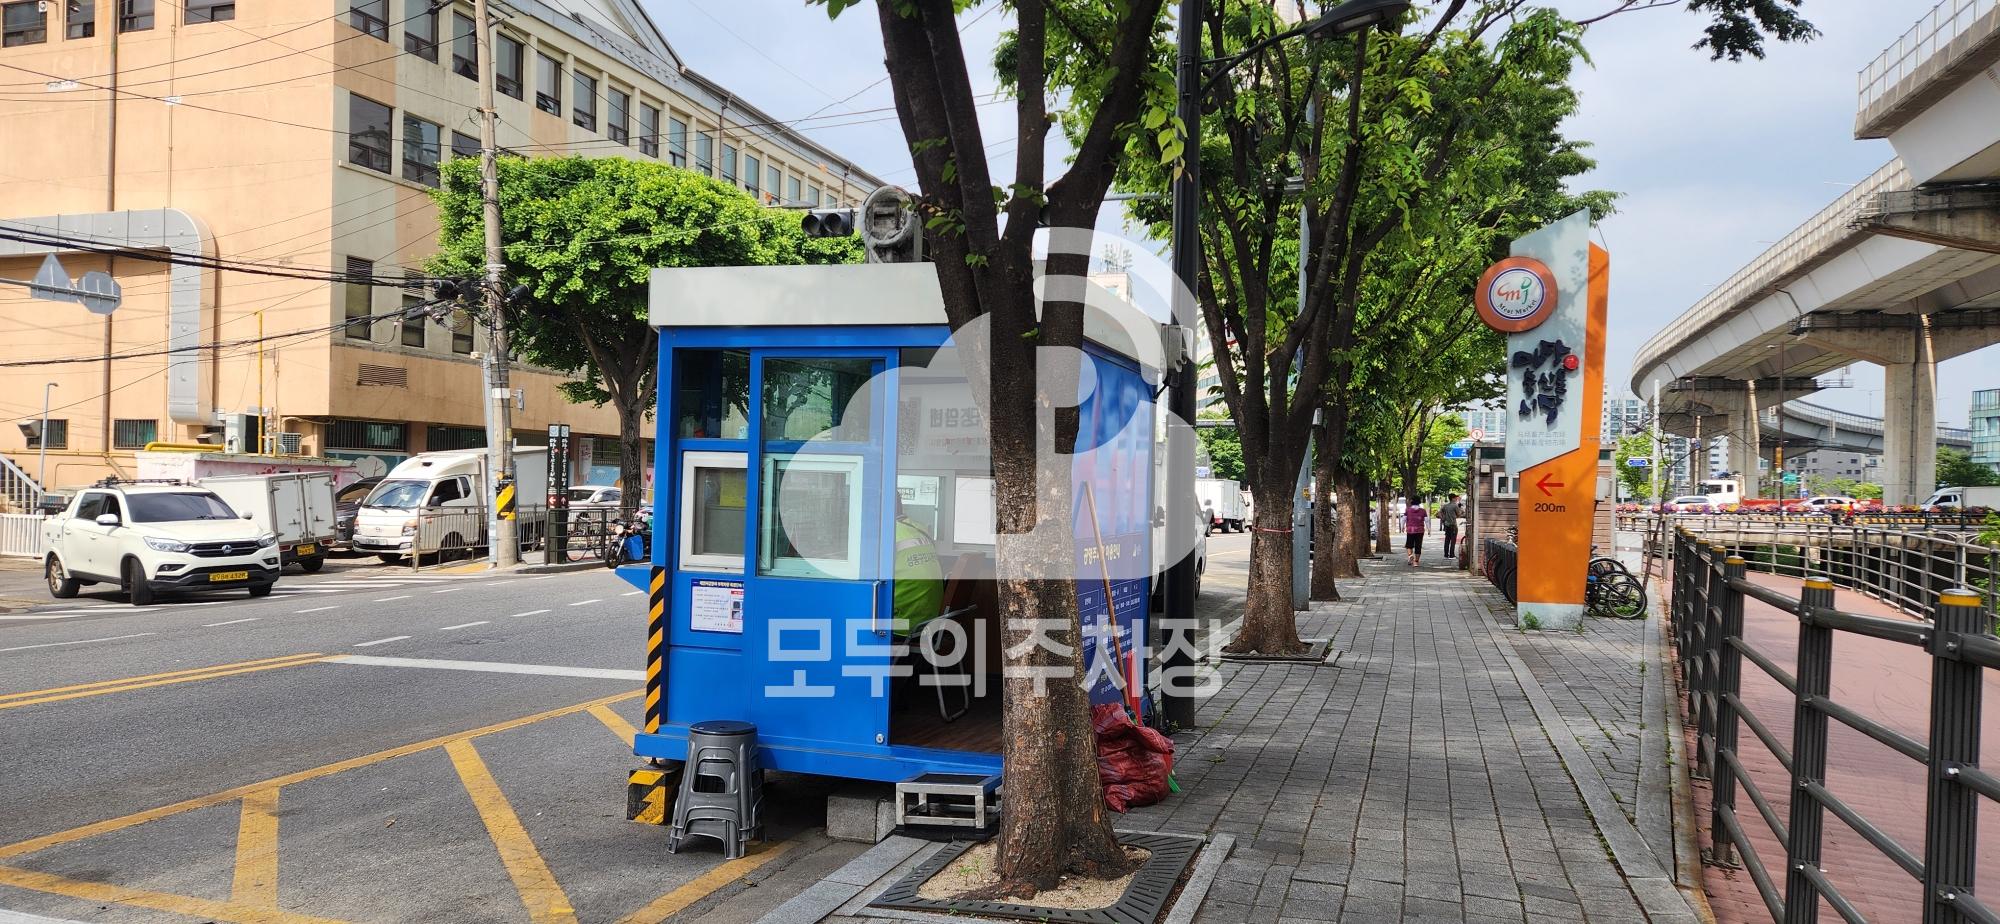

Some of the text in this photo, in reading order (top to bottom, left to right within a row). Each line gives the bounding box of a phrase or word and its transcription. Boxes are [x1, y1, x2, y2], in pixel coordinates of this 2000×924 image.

[1498, 299, 1538, 315] Meat Market
[1518, 393, 1563, 426] 시장
[1534, 502, 1566, 513] 200m
